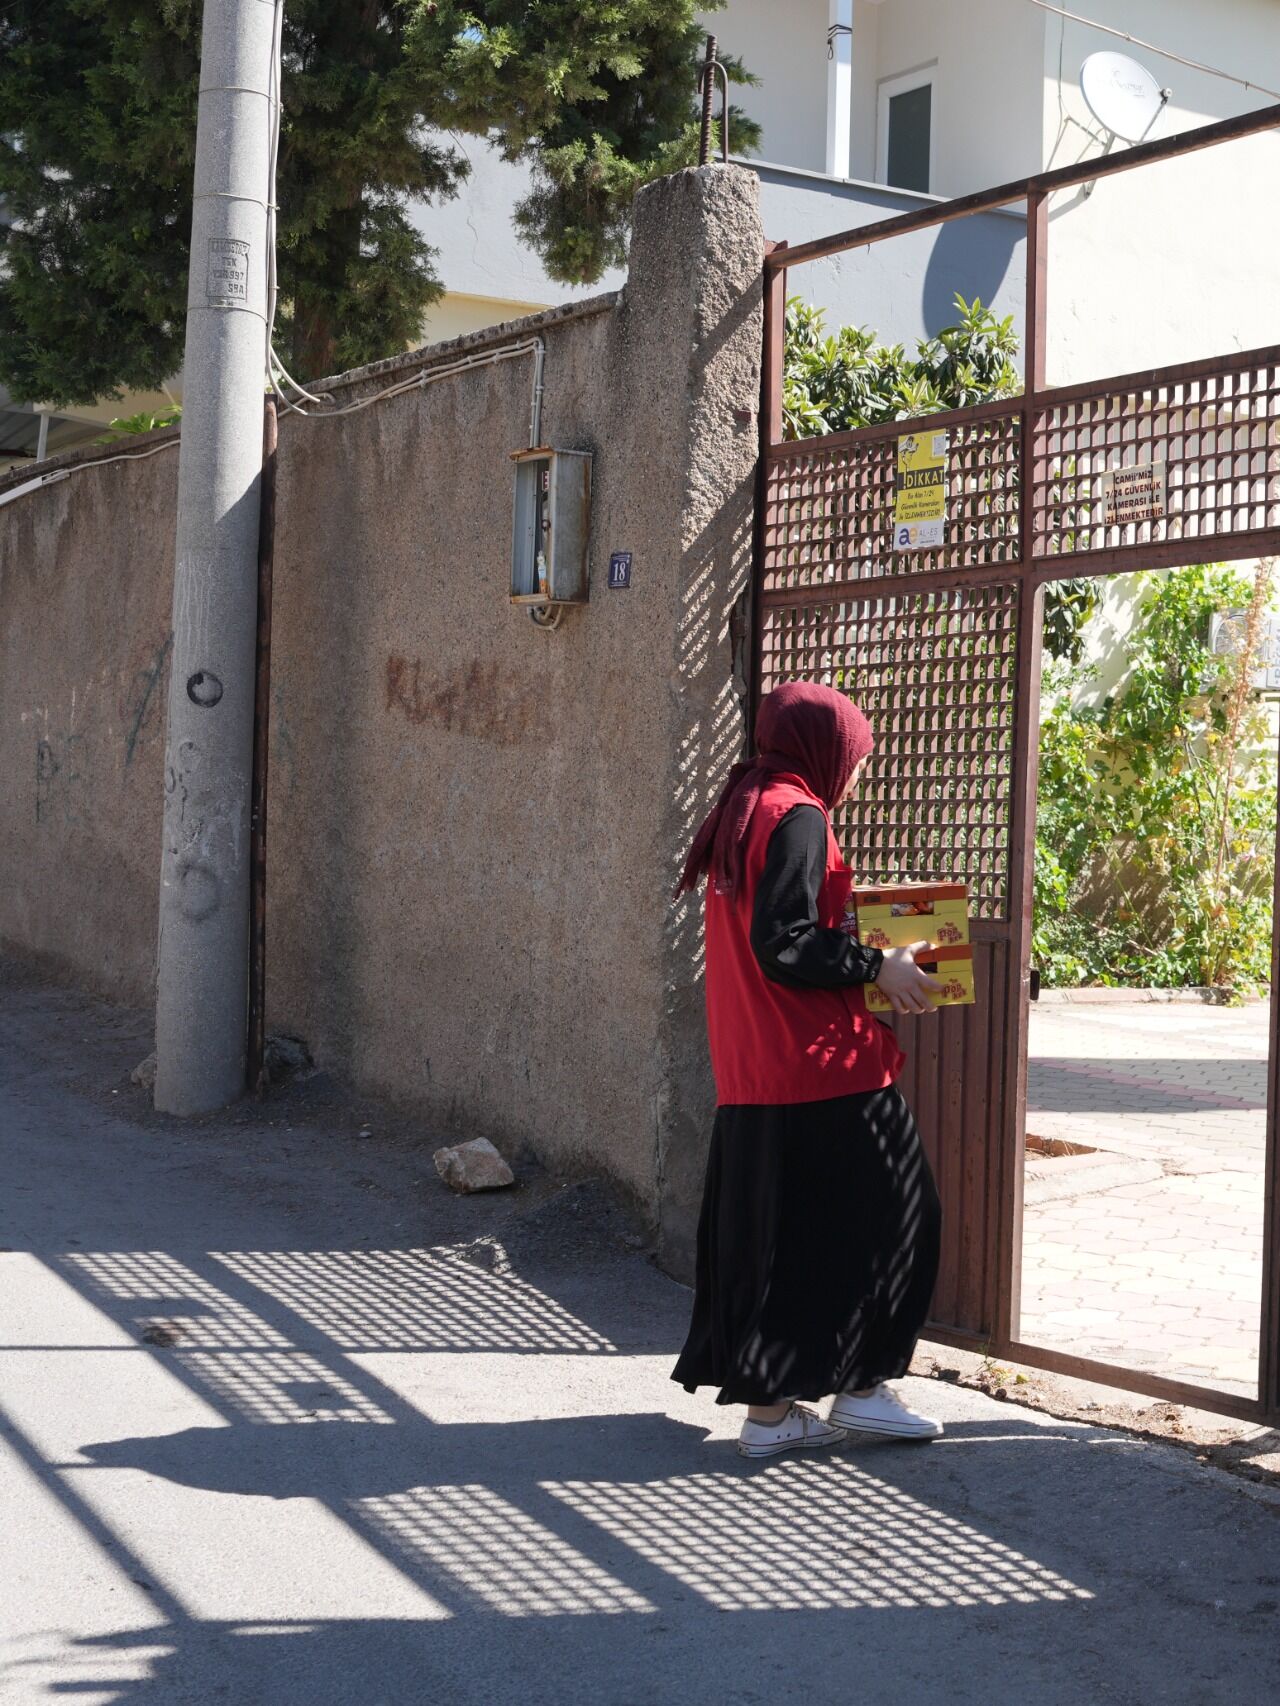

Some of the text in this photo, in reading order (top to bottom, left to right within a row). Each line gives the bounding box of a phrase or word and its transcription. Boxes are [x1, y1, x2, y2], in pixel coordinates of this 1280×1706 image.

[1105, 481, 1161, 499] 7/24 GÜVENLİK
[1107, 497, 1147, 511] KAMERASI
[1104, 507, 1163, 524] İZLENMEKTEDİR
[613, 562, 626, 581] 18
